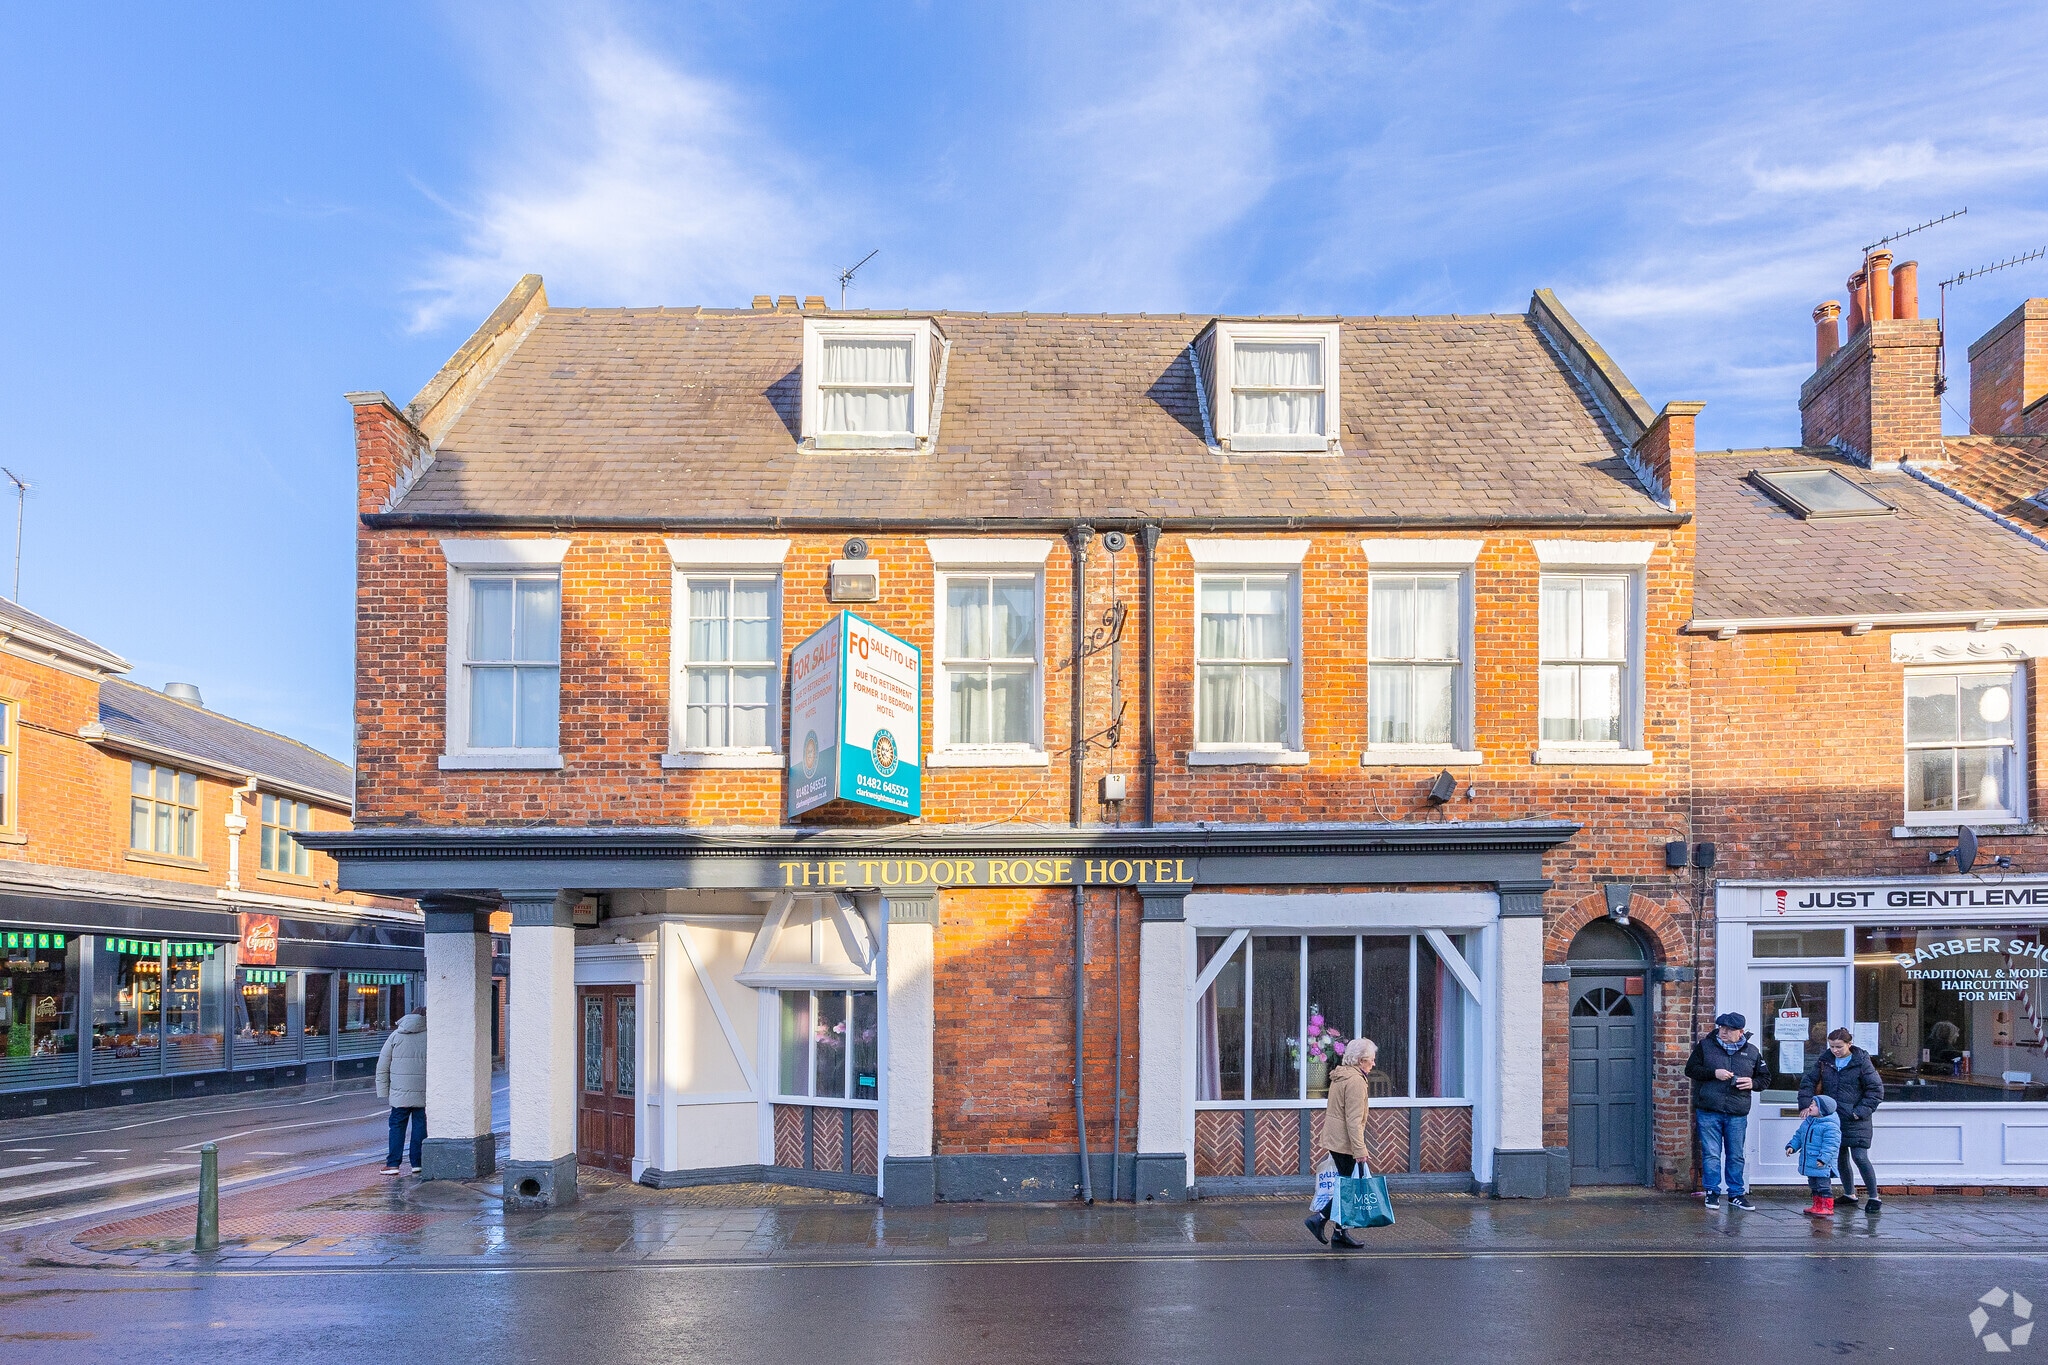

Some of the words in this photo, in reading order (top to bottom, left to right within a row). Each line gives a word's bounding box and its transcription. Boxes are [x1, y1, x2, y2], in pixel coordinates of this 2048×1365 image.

[794, 653, 810, 685] FOR
[812, 634, 837, 670] SALE
[905, 656, 917, 672] LET
[856, 669, 868, 681] DUE
[870, 674, 878, 684] TO
[879, 679, 912, 700] RETIREMENT
[853, 682, 879, 698] FORMER
[880, 692, 887, 702] 10
[888, 696, 914, 713] BEDROOM
[876, 704, 895, 718] HOTEL
[857, 774, 881, 790] 01482
[883, 781, 909, 798] 645522
[779, 860, 848, 886] THE
[858, 859, 977, 885] TUDOR
[987, 859, 1073, 884] ROSE
[1084, 859, 1194, 884] HOTEL
[1798, 891, 1875, 908] JUST
[1886, 889, 2048, 907] GENTLEME
[1894, 937, 2000, 969] BARBER
[1905, 969, 1991, 979] TRADITIONAL
[1995, 969, 2006, 979] &
[2009, 968, 2048, 978] MODE
[1941, 980, 2029, 990] HAIRCUTTING
[1958, 991, 1984, 1001] FOR
[1988, 991, 2016, 1001] MEN
[1781, 1010, 1799, 1018] OPEN
[1354, 1192, 1378, 1204] M&S
